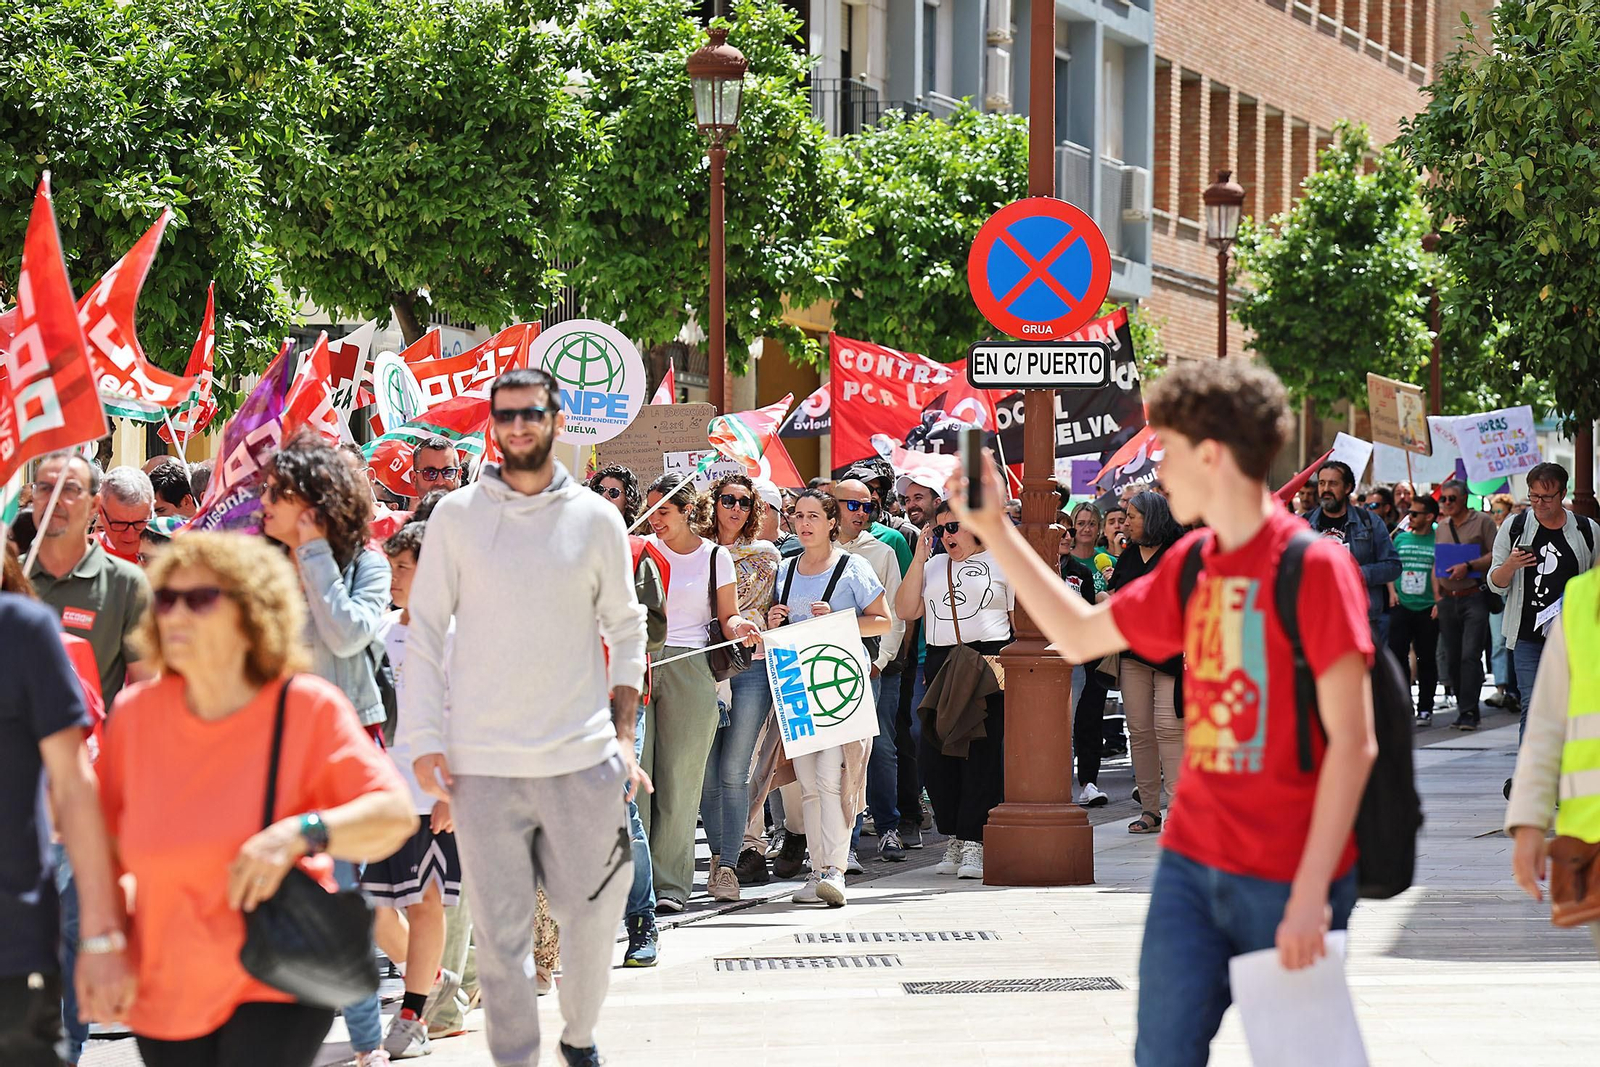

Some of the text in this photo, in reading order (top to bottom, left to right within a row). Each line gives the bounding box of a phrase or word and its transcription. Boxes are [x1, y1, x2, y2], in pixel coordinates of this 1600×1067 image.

[1022, 324, 1053, 334] GRUA
[974, 352, 1103, 375] EN C/ PUERTO
[560, 389, 629, 419] NPE
[1476, 417, 1508, 433] HORAS
[773, 643, 817, 742] ANPE
[774, 686, 792, 743] INDEPENDIENTE
